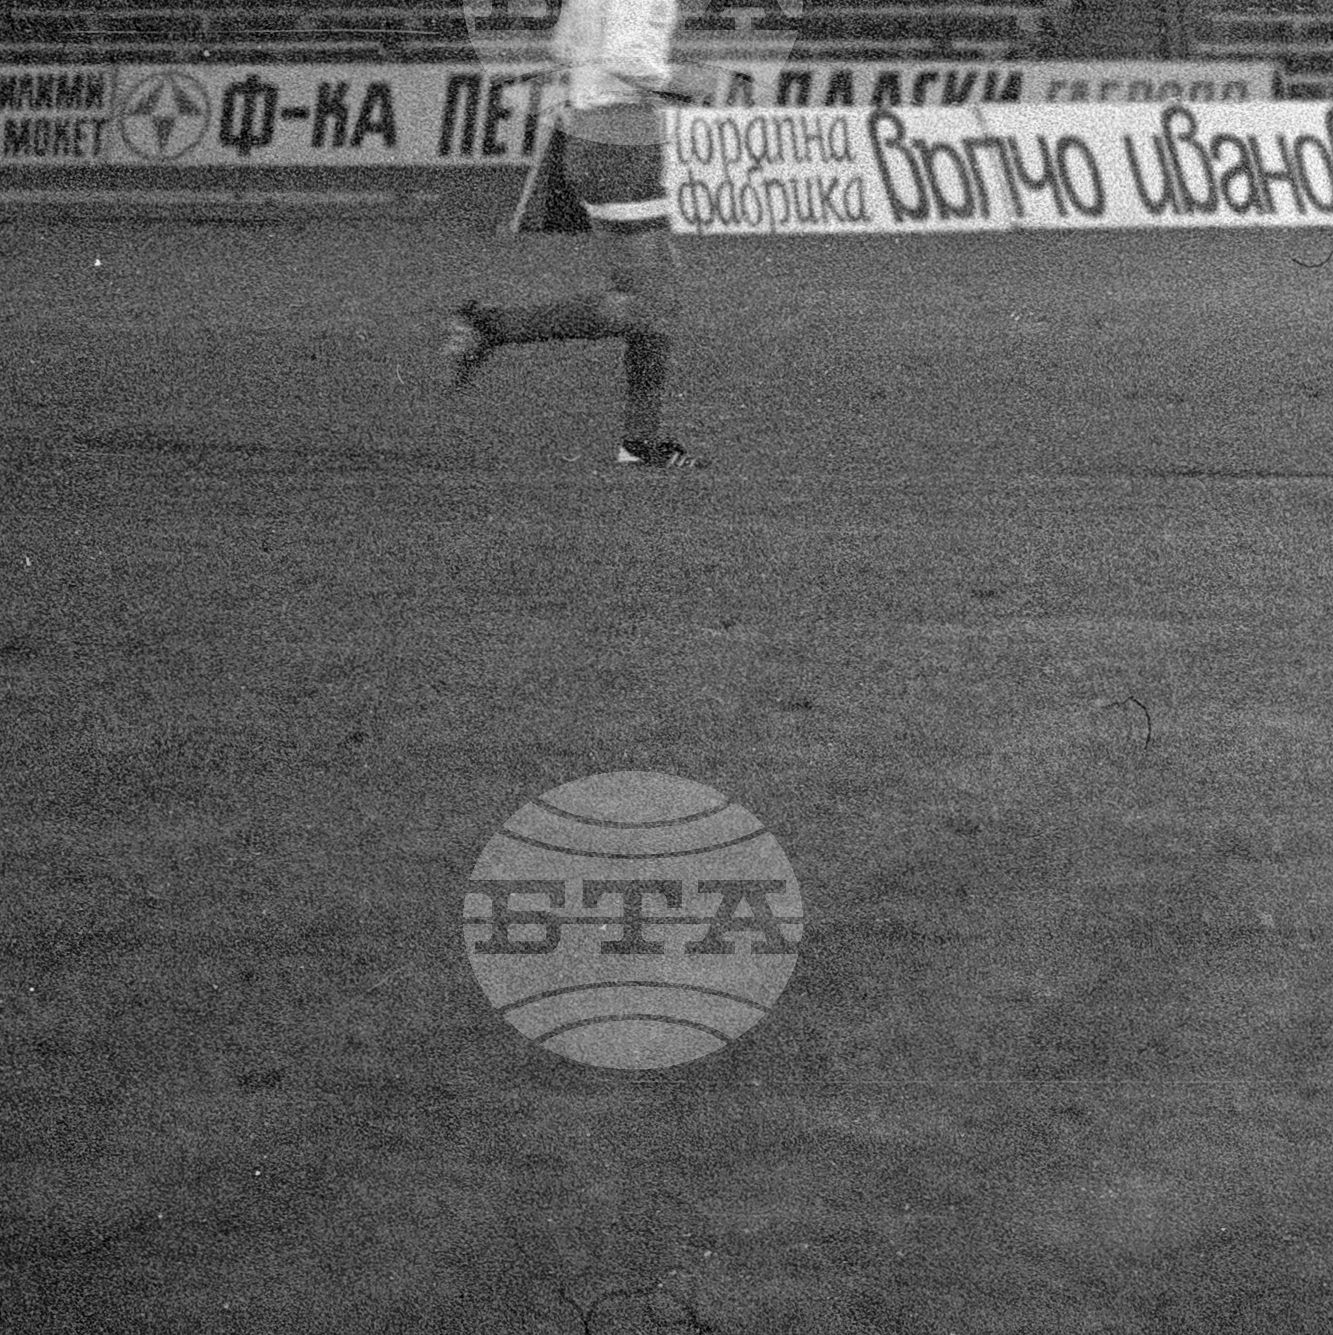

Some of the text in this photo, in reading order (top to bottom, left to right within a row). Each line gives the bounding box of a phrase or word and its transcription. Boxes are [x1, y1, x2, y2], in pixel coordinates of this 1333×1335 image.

[3, 117, 108, 157] МОКЕТ
[218, 72, 556, 157] Ф-КА ПЕТ
[676, 162, 874, 234] фабрика
